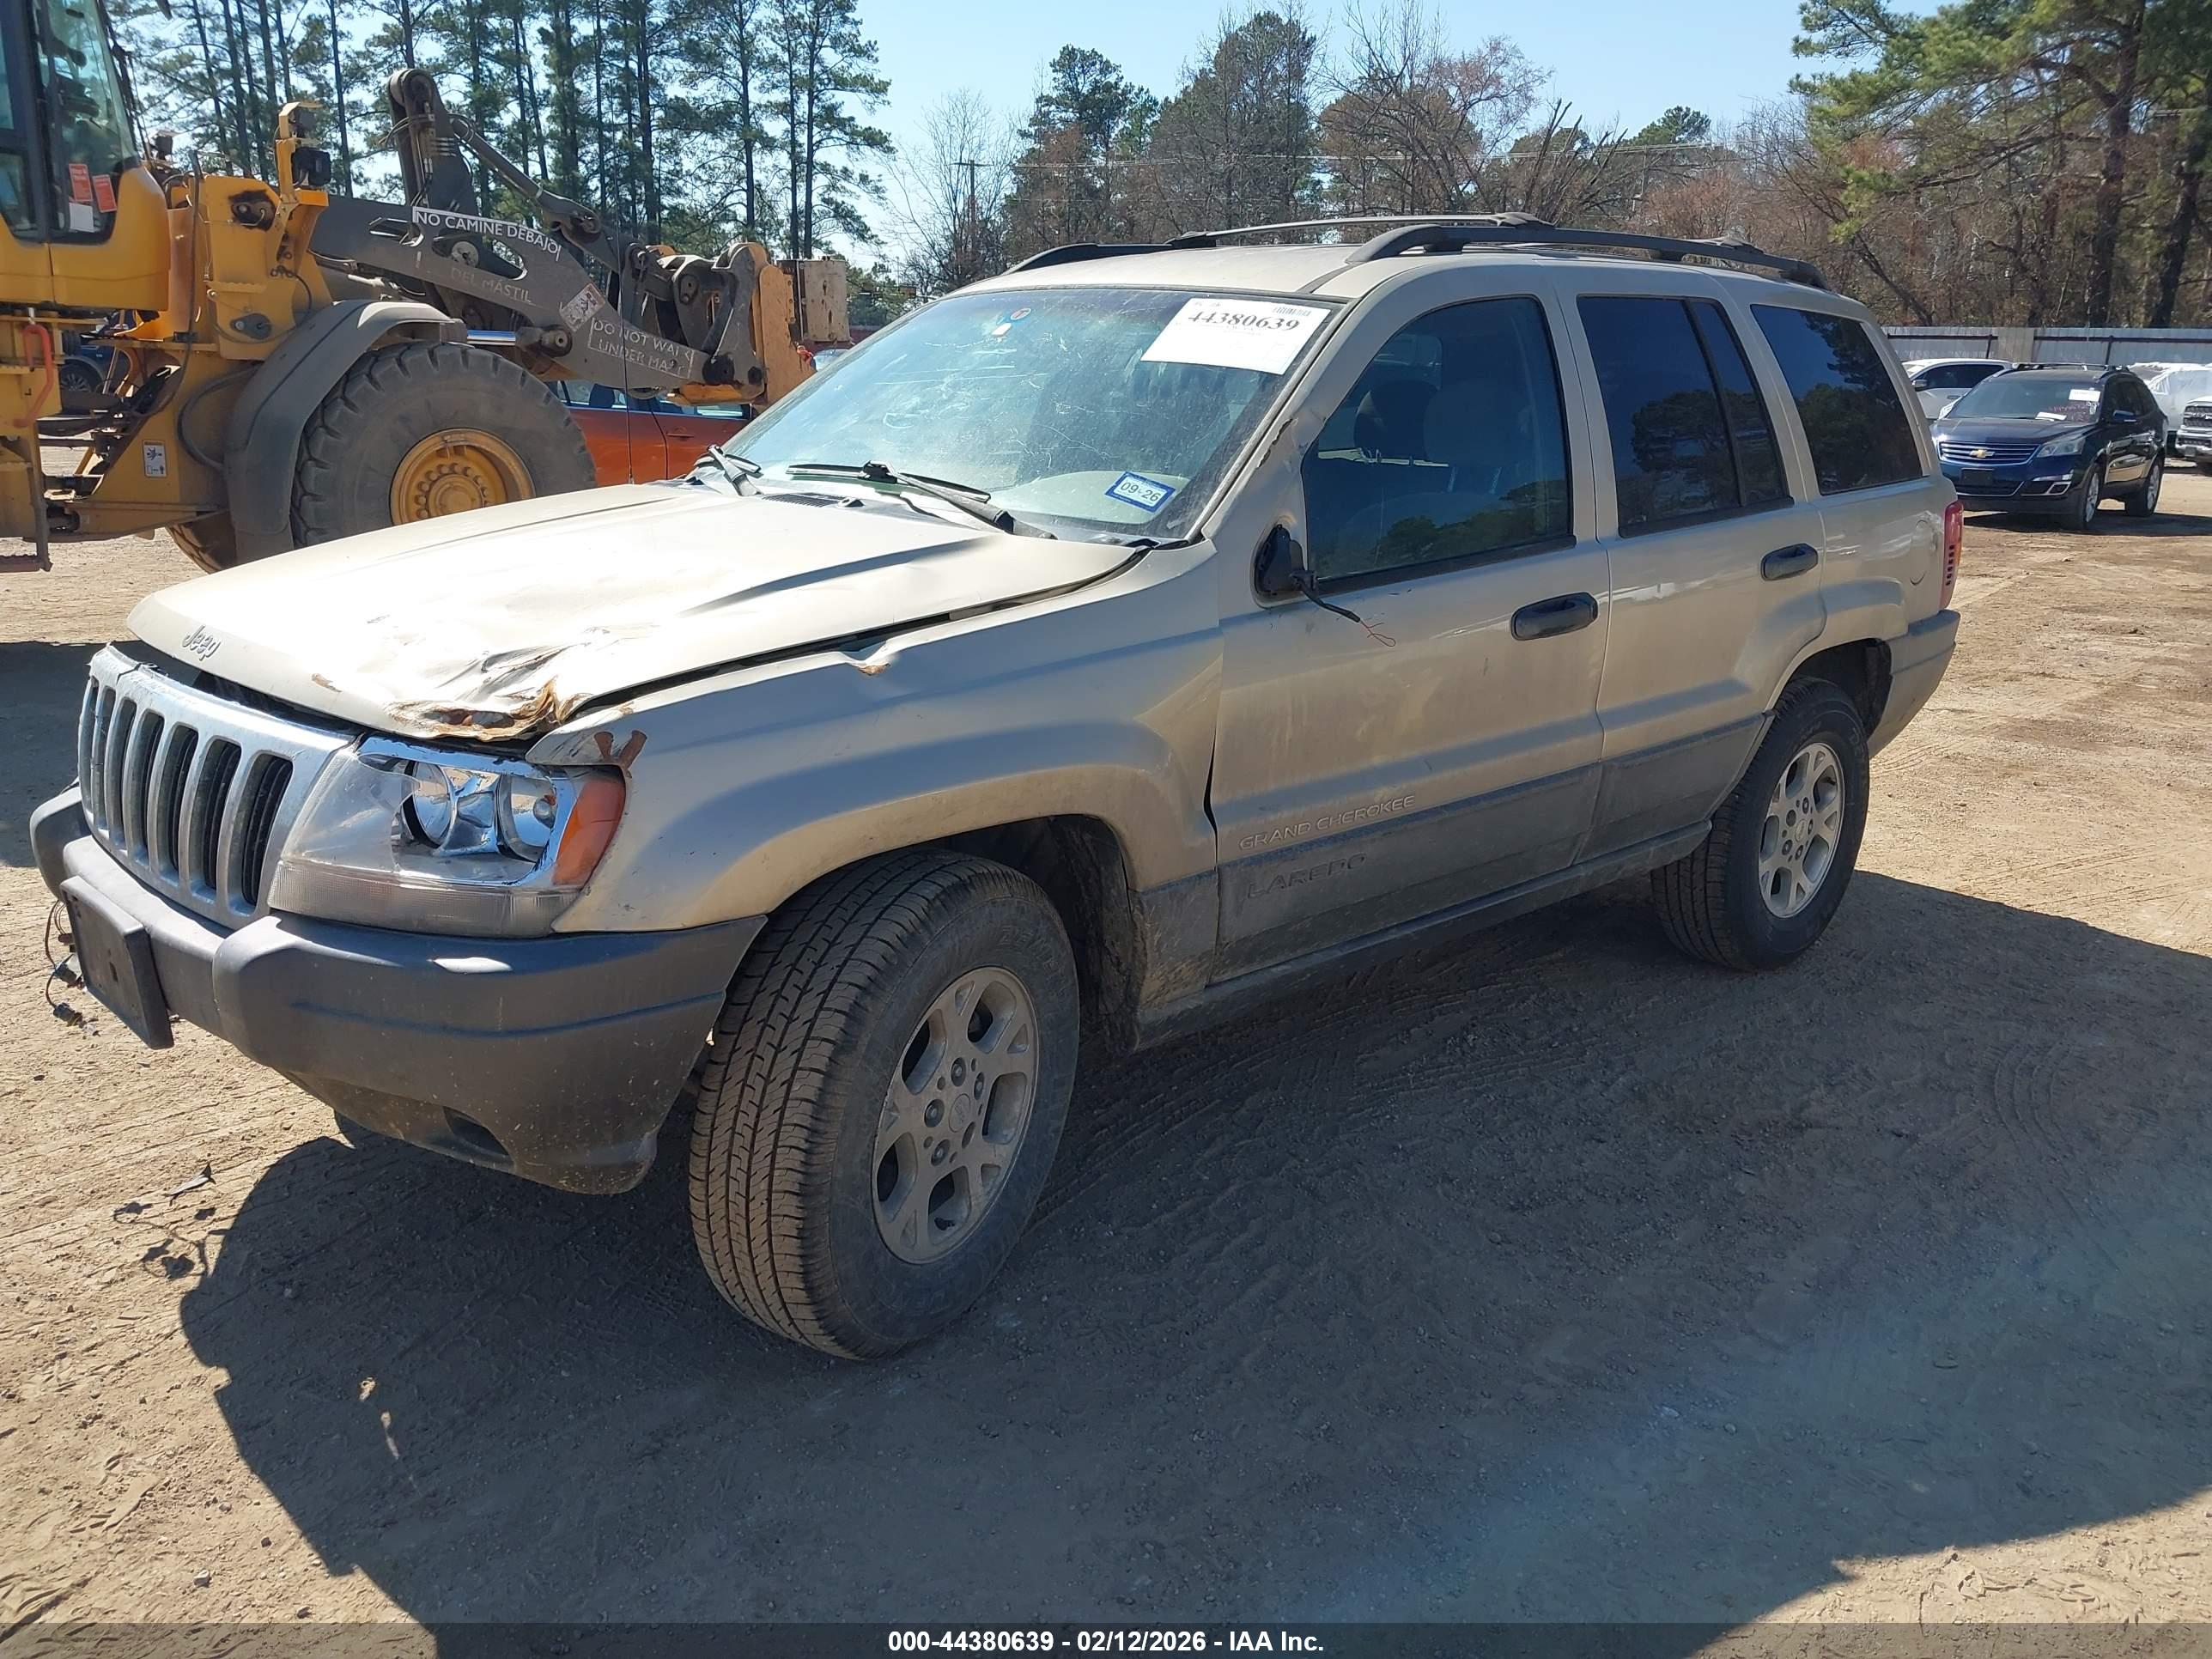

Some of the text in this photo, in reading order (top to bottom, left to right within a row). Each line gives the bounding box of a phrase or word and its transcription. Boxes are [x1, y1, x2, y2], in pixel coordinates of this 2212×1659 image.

[415, 211, 558, 255] NO CAMINE DEBAJO
[451, 267, 476, 284] DEL
[593, 319, 616, 335] DO
[619, 328, 647, 346] NOT
[1188, 311, 1300, 331] 44380639
[599, 339, 645, 362] UNDER
[1120, 482, 1139, 494] 09
[1141, 489, 1162, 502] 26
[182, 624, 221, 661] Jeep
[1239, 795, 1416, 850] GRAND CHEROKEE
[1247, 851, 1368, 898] LAREDO
